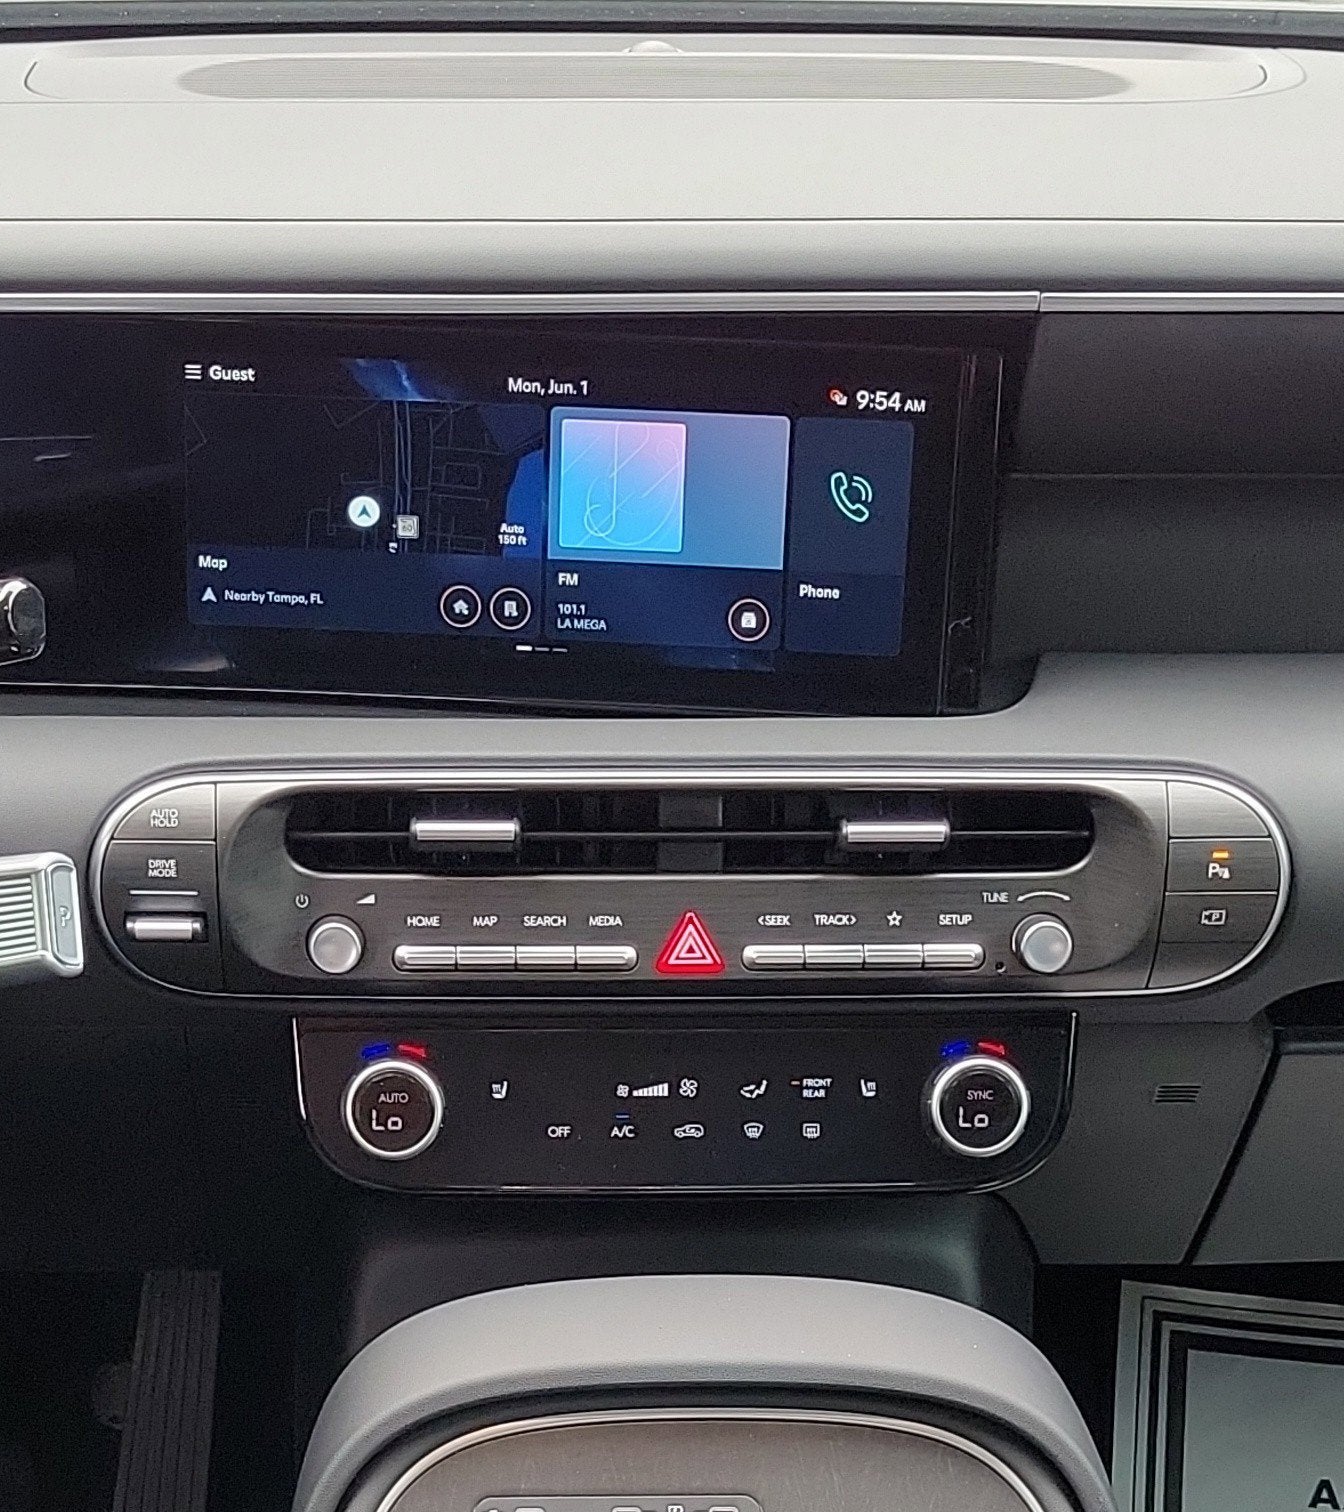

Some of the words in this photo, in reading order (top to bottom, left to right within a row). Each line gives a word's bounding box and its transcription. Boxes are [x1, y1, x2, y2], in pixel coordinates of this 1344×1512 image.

[209, 365, 256, 382] Guest
[508, 378, 545, 396] Mon,
[548, 379, 578, 395] Jun.
[580, 380, 588, 396] 1
[856, 391, 901, 412] 9:54
[904, 399, 926, 413] AM
[500, 523, 525, 533] Auto
[498, 535, 516, 545] 150
[517, 536, 527, 545] ft
[198, 556, 228, 571] Map
[558, 573, 578, 586] FM
[224, 590, 265, 604] Nearby
[267, 591, 309, 605] Tampa,
[310, 593, 323, 604] FL
[799, 584, 840, 600] Phone
[558, 603, 586, 616] 101.1
[557, 617, 571, 629] LA
[572, 618, 607, 631] MEGA
[150, 808, 178, 818] AUTO
[150, 818, 179, 828] HOLD
[148, 859, 176, 868] DRIVE
[148, 868, 177, 877] MODE
[982, 892, 1009, 903] TUNE
[407, 916, 440, 927] HOME
[473, 916, 498, 927] MAP
[523, 916, 567, 927] SEARCH
[589, 916, 622, 927] MEDIA
[939, 915, 972, 926] SETUP
[802, 1078, 832, 1088] FRONT
[378, 1092, 409, 1104] AUTO
[803, 1089, 826, 1098] REAR
[967, 1090, 993, 1100] SYNC
[548, 1125, 571, 1138] OFF
[610, 1125, 635, 1138] A/C
